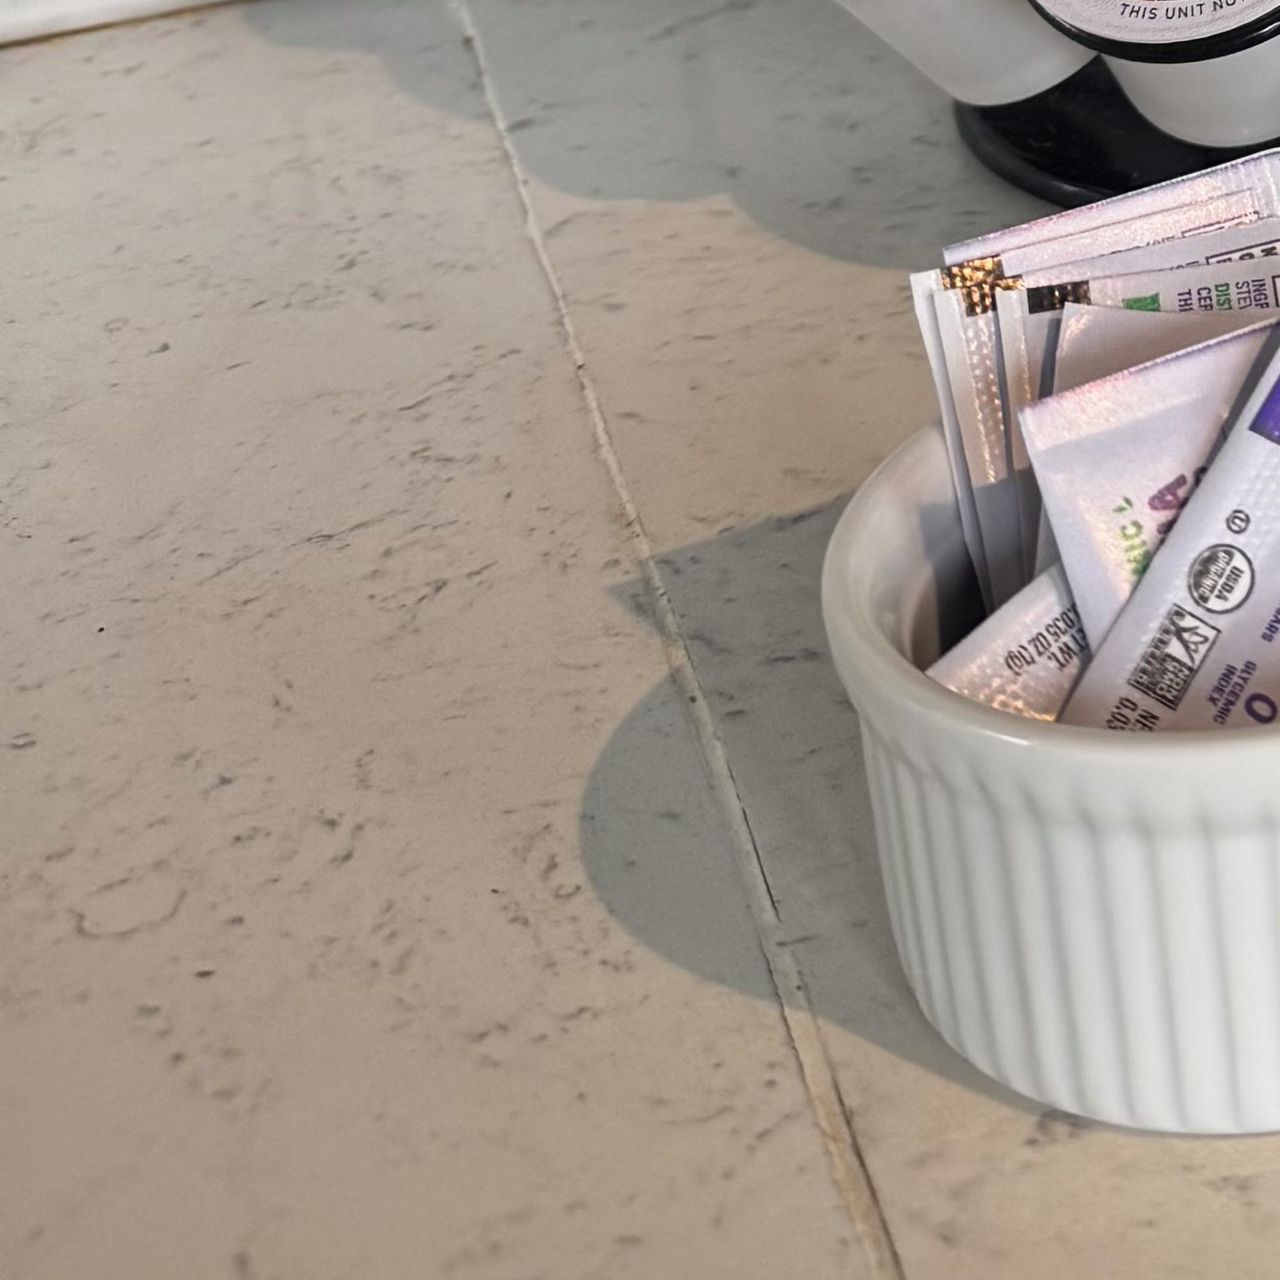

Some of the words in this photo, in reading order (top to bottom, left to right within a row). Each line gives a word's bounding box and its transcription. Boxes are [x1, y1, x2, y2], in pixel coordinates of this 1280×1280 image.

[1120, 2, 1158, 21] THIS
[1164, 2, 1206, 21] UNIT
[1214, 565, 1246, 603] USDA
[1206, 662, 1239, 707] INDEX
[1212, 659, 1258, 726] GLYCEMIC
[1244, 691, 1279, 725] 0
